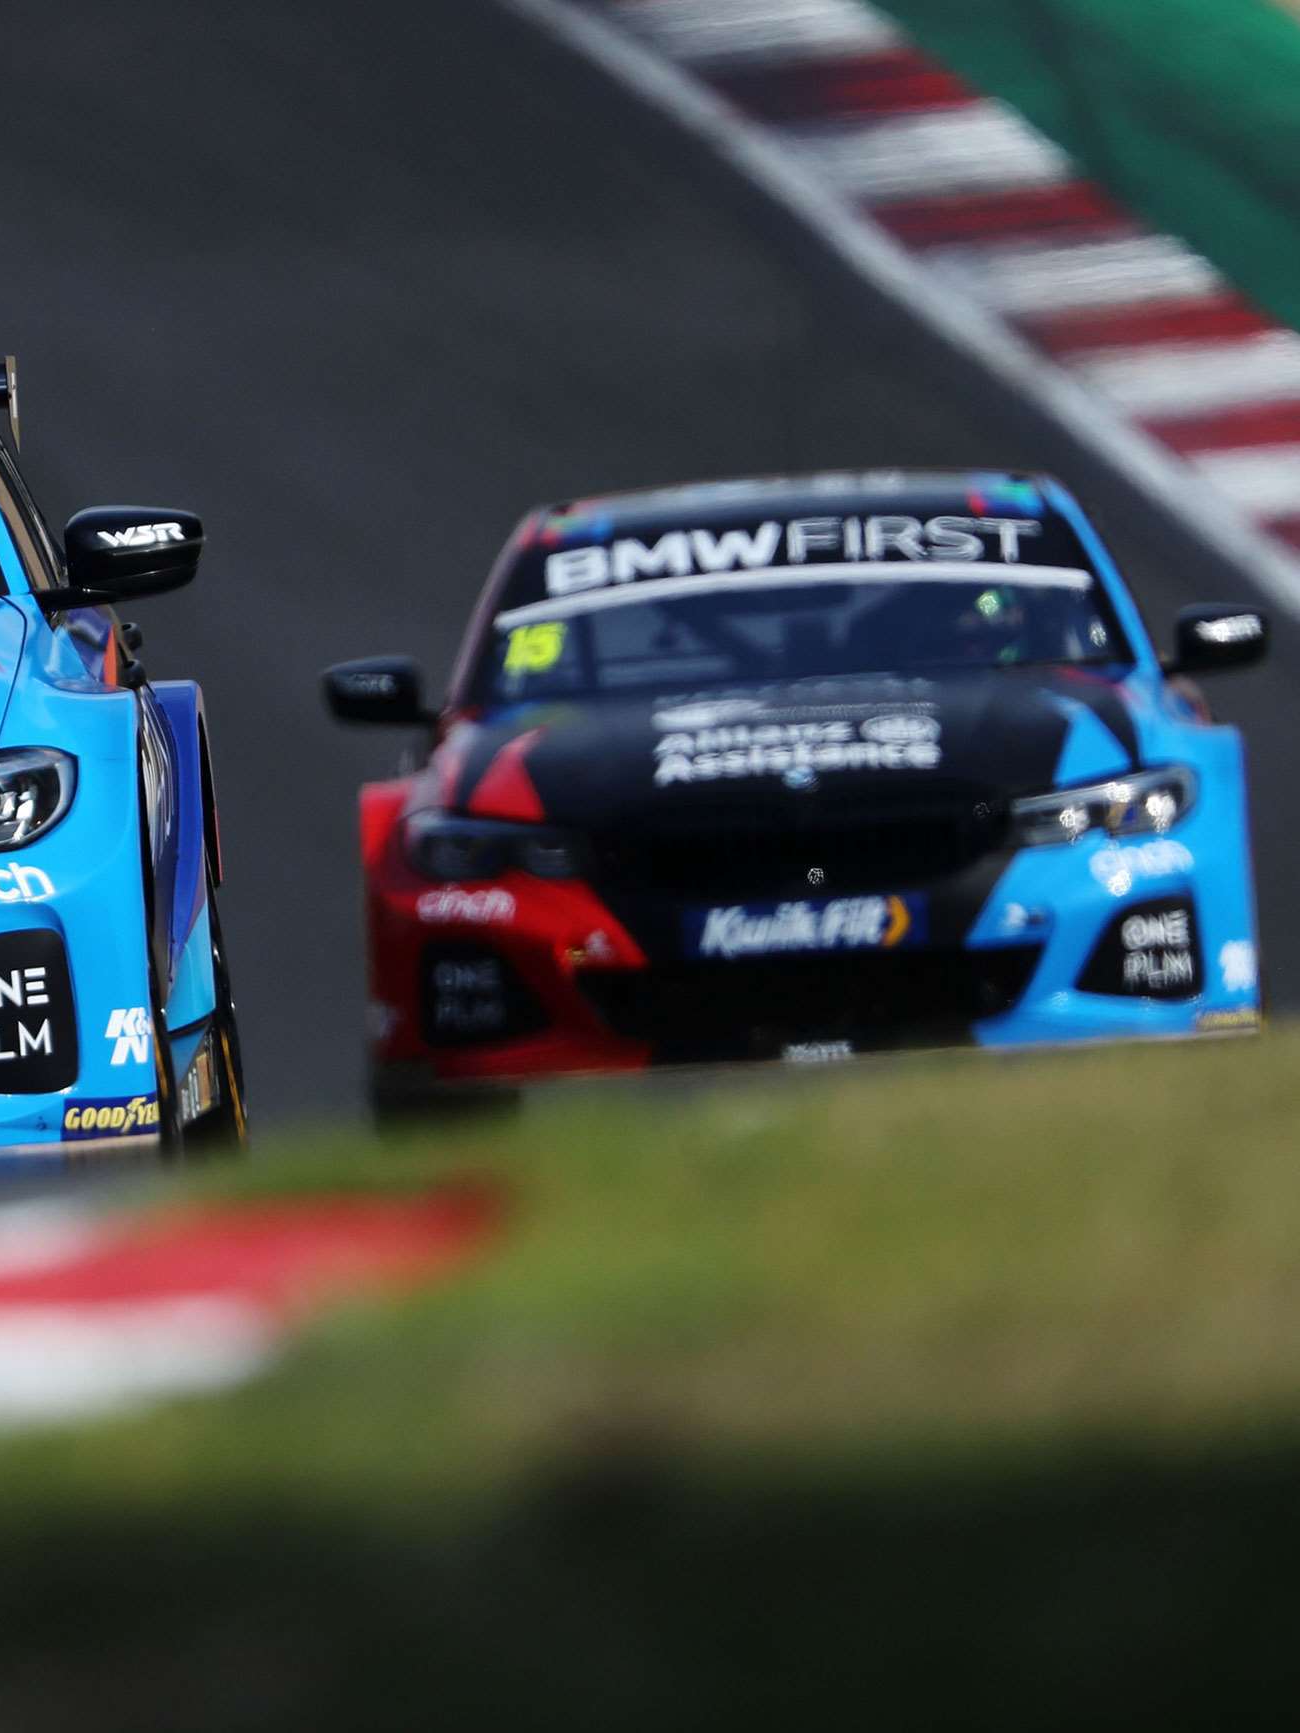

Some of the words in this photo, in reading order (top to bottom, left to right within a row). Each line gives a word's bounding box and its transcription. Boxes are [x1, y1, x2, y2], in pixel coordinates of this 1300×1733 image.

[96, 522, 187, 548] WSR
[502, 621, 567, 676] 15
[654, 741, 942, 788] Assistance
